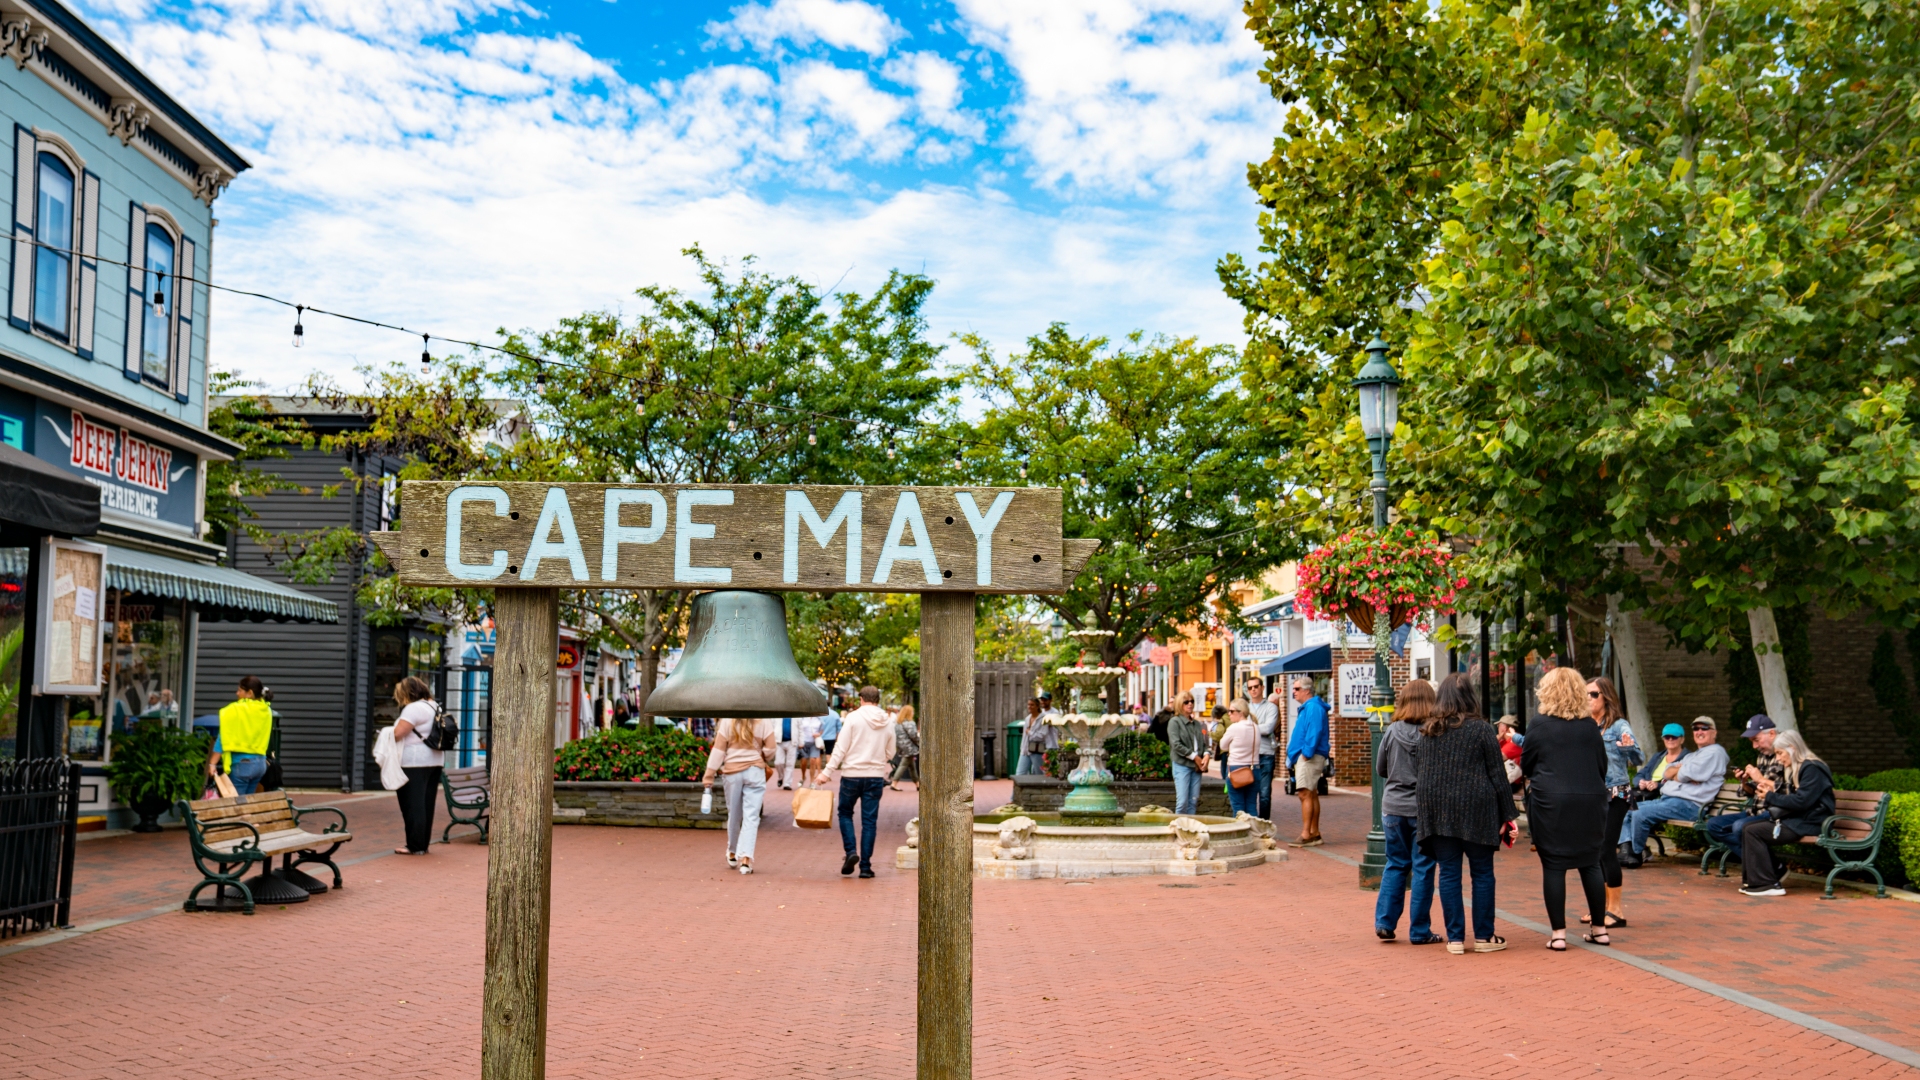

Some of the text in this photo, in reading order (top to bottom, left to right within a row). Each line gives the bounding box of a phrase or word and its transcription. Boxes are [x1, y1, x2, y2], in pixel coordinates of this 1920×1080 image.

[71, 410, 115, 477] BEEF
[116, 427, 172, 494] JERKY
[85, 476, 158, 519] PERIENCE
[445, 485, 1016, 588] CAPE MAY
[1240, 643, 1278, 652] KITCHEN
[1346, 667, 1365, 680] CAPE
